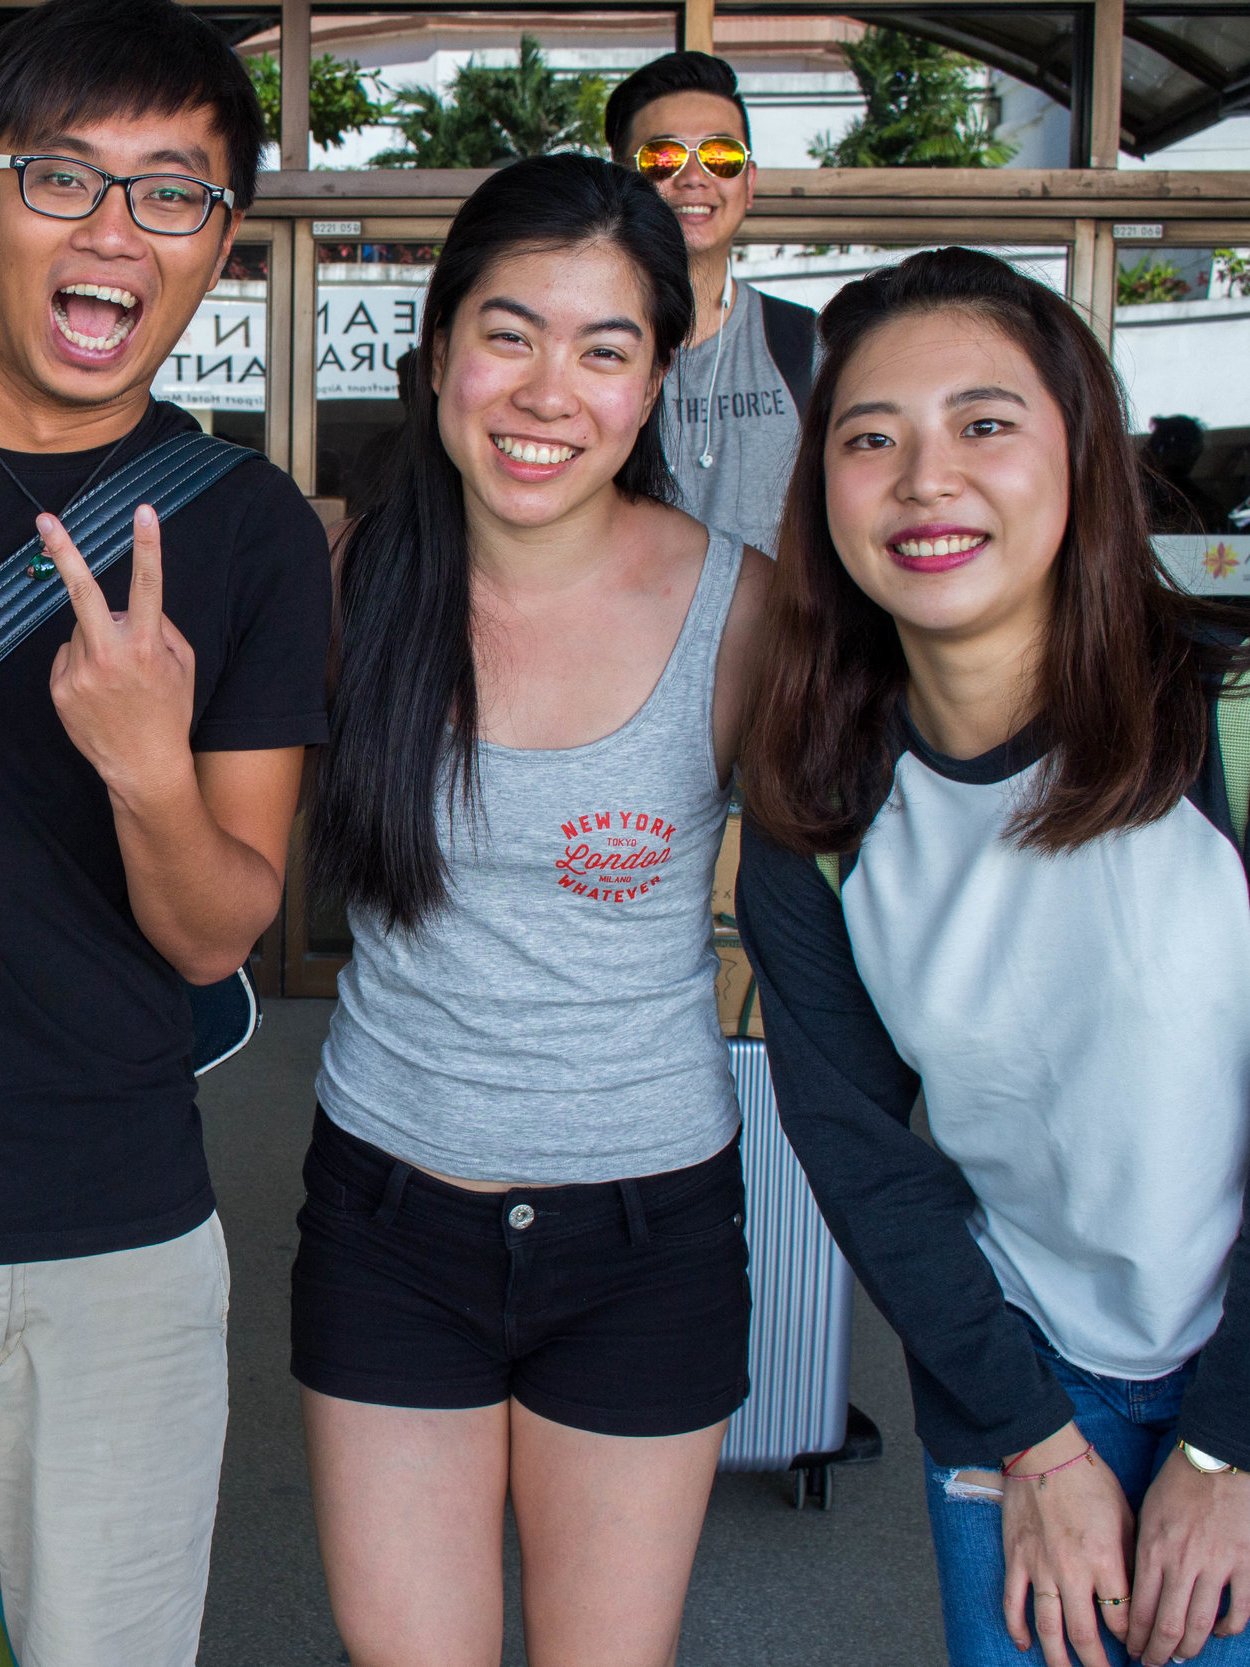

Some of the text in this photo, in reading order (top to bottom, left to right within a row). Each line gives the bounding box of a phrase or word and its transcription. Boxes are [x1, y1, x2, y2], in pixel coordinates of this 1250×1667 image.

[672, 388, 785, 424] THE FORCE
[560, 811, 678, 843] NEW YORK
[607, 837, 637, 847] TOKYO
[555, 843, 672, 875] London
[557, 873, 662, 903] WHATEVER
[598, 875, 632, 884] MILANO
